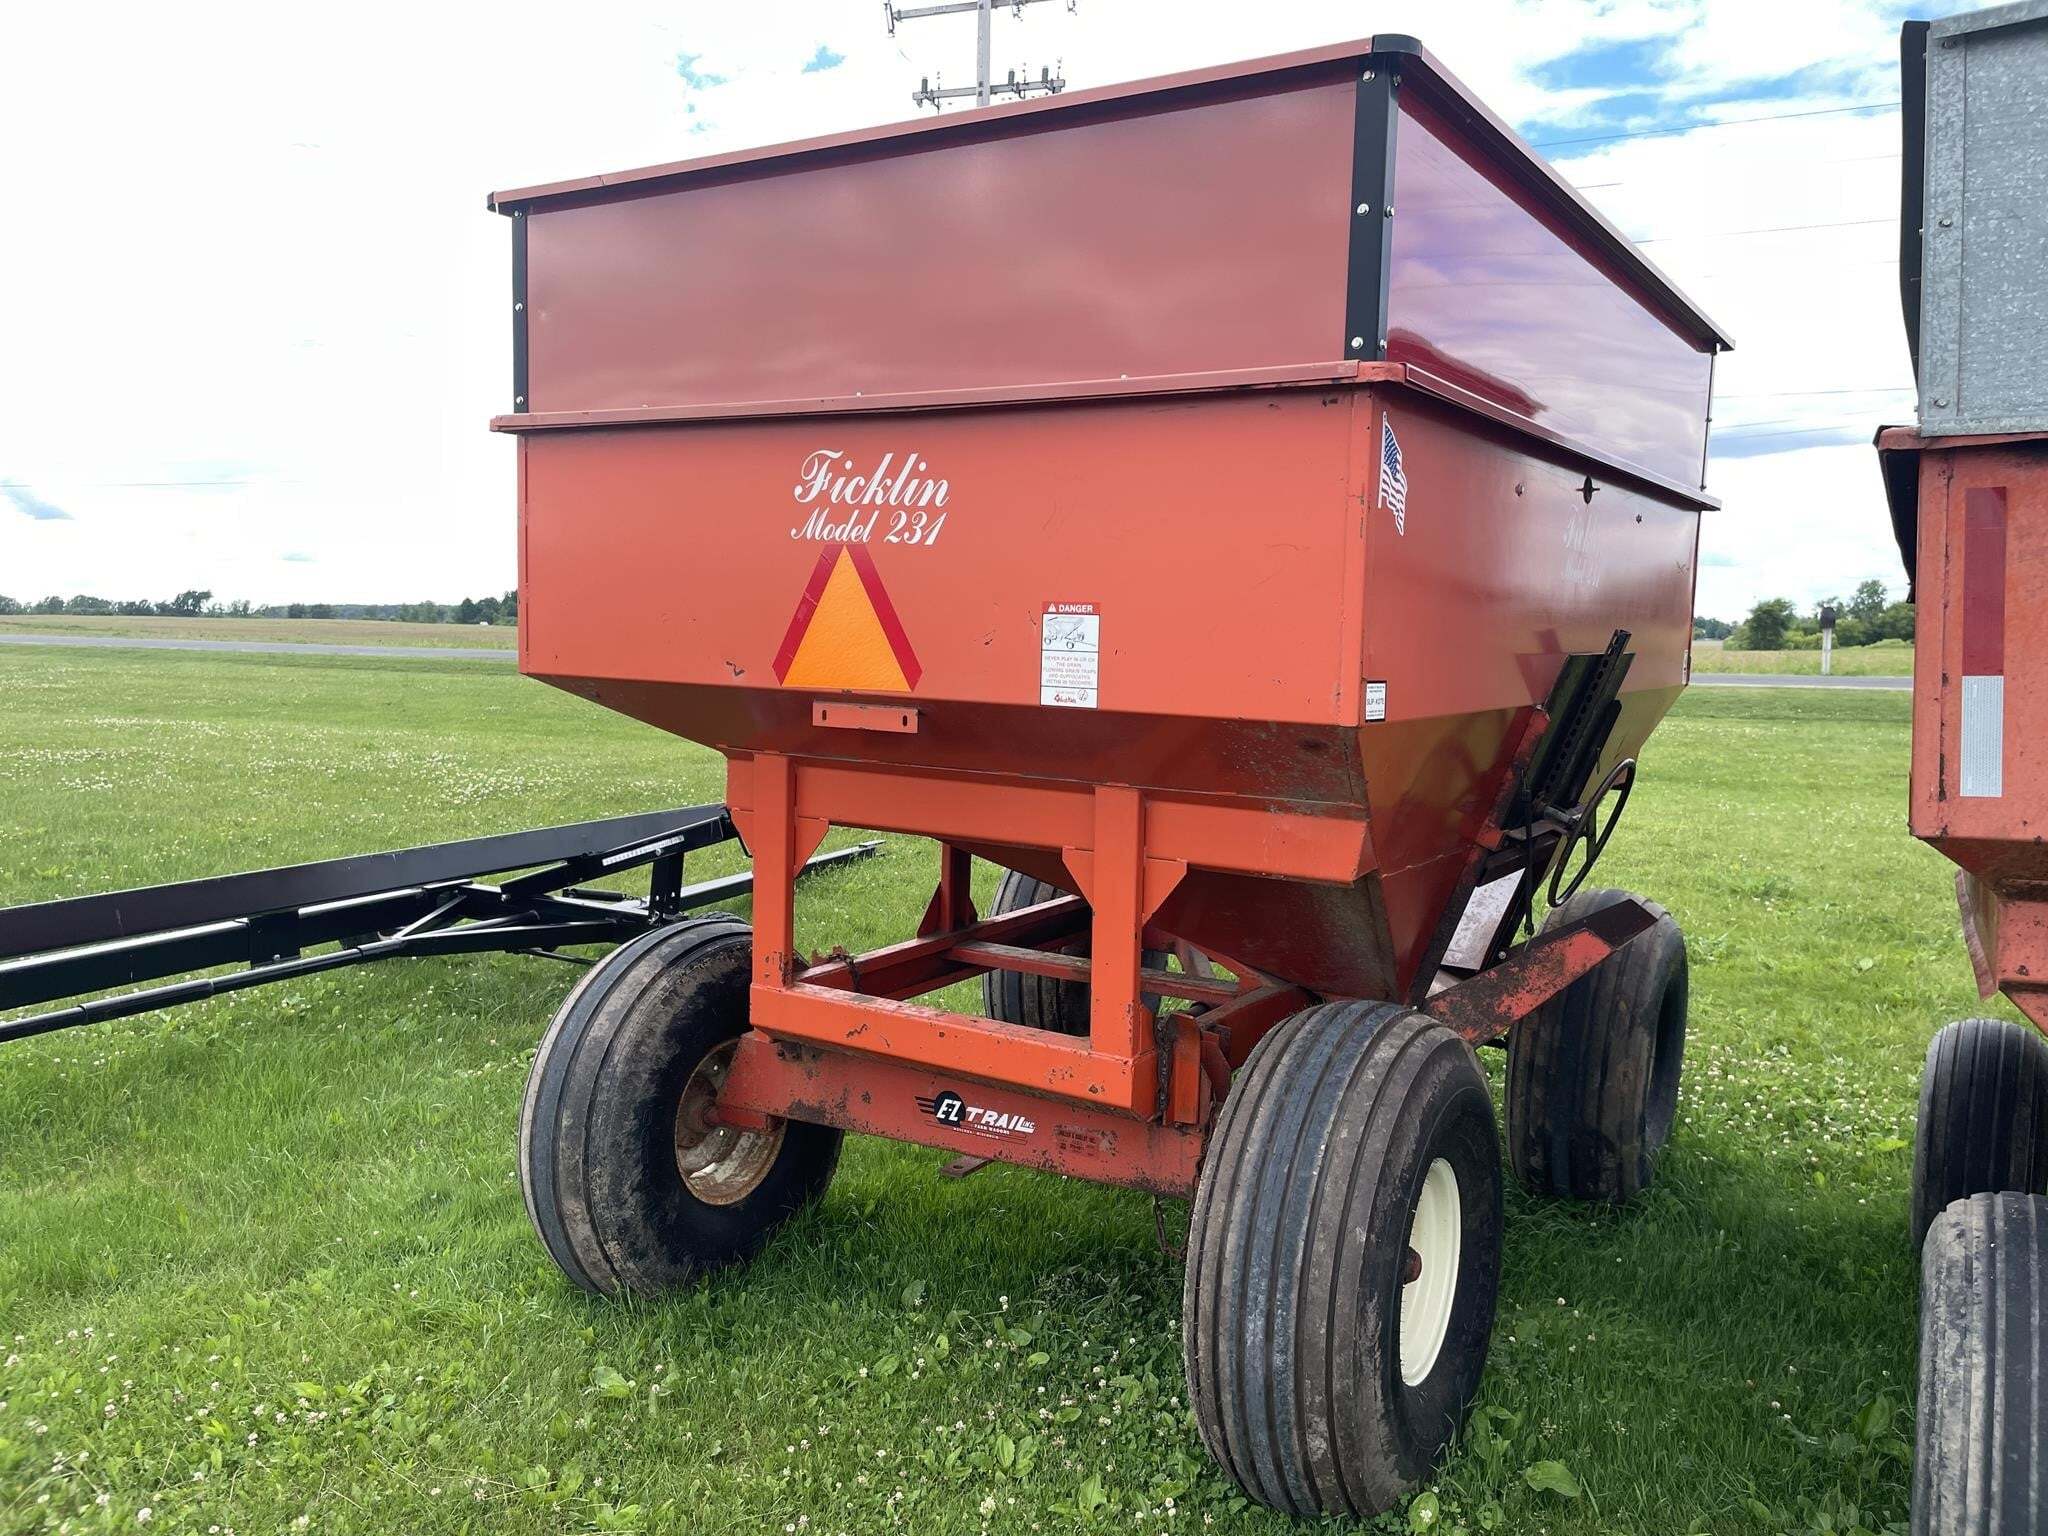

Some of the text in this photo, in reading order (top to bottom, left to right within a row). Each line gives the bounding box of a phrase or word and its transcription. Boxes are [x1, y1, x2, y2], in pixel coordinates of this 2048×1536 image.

[793, 449, 950, 508] Ficklin
[790, 506, 948, 546] Model 231
[1058, 604, 1093, 613] DANGER
[965, 1106, 1035, 1134] TRAIL
